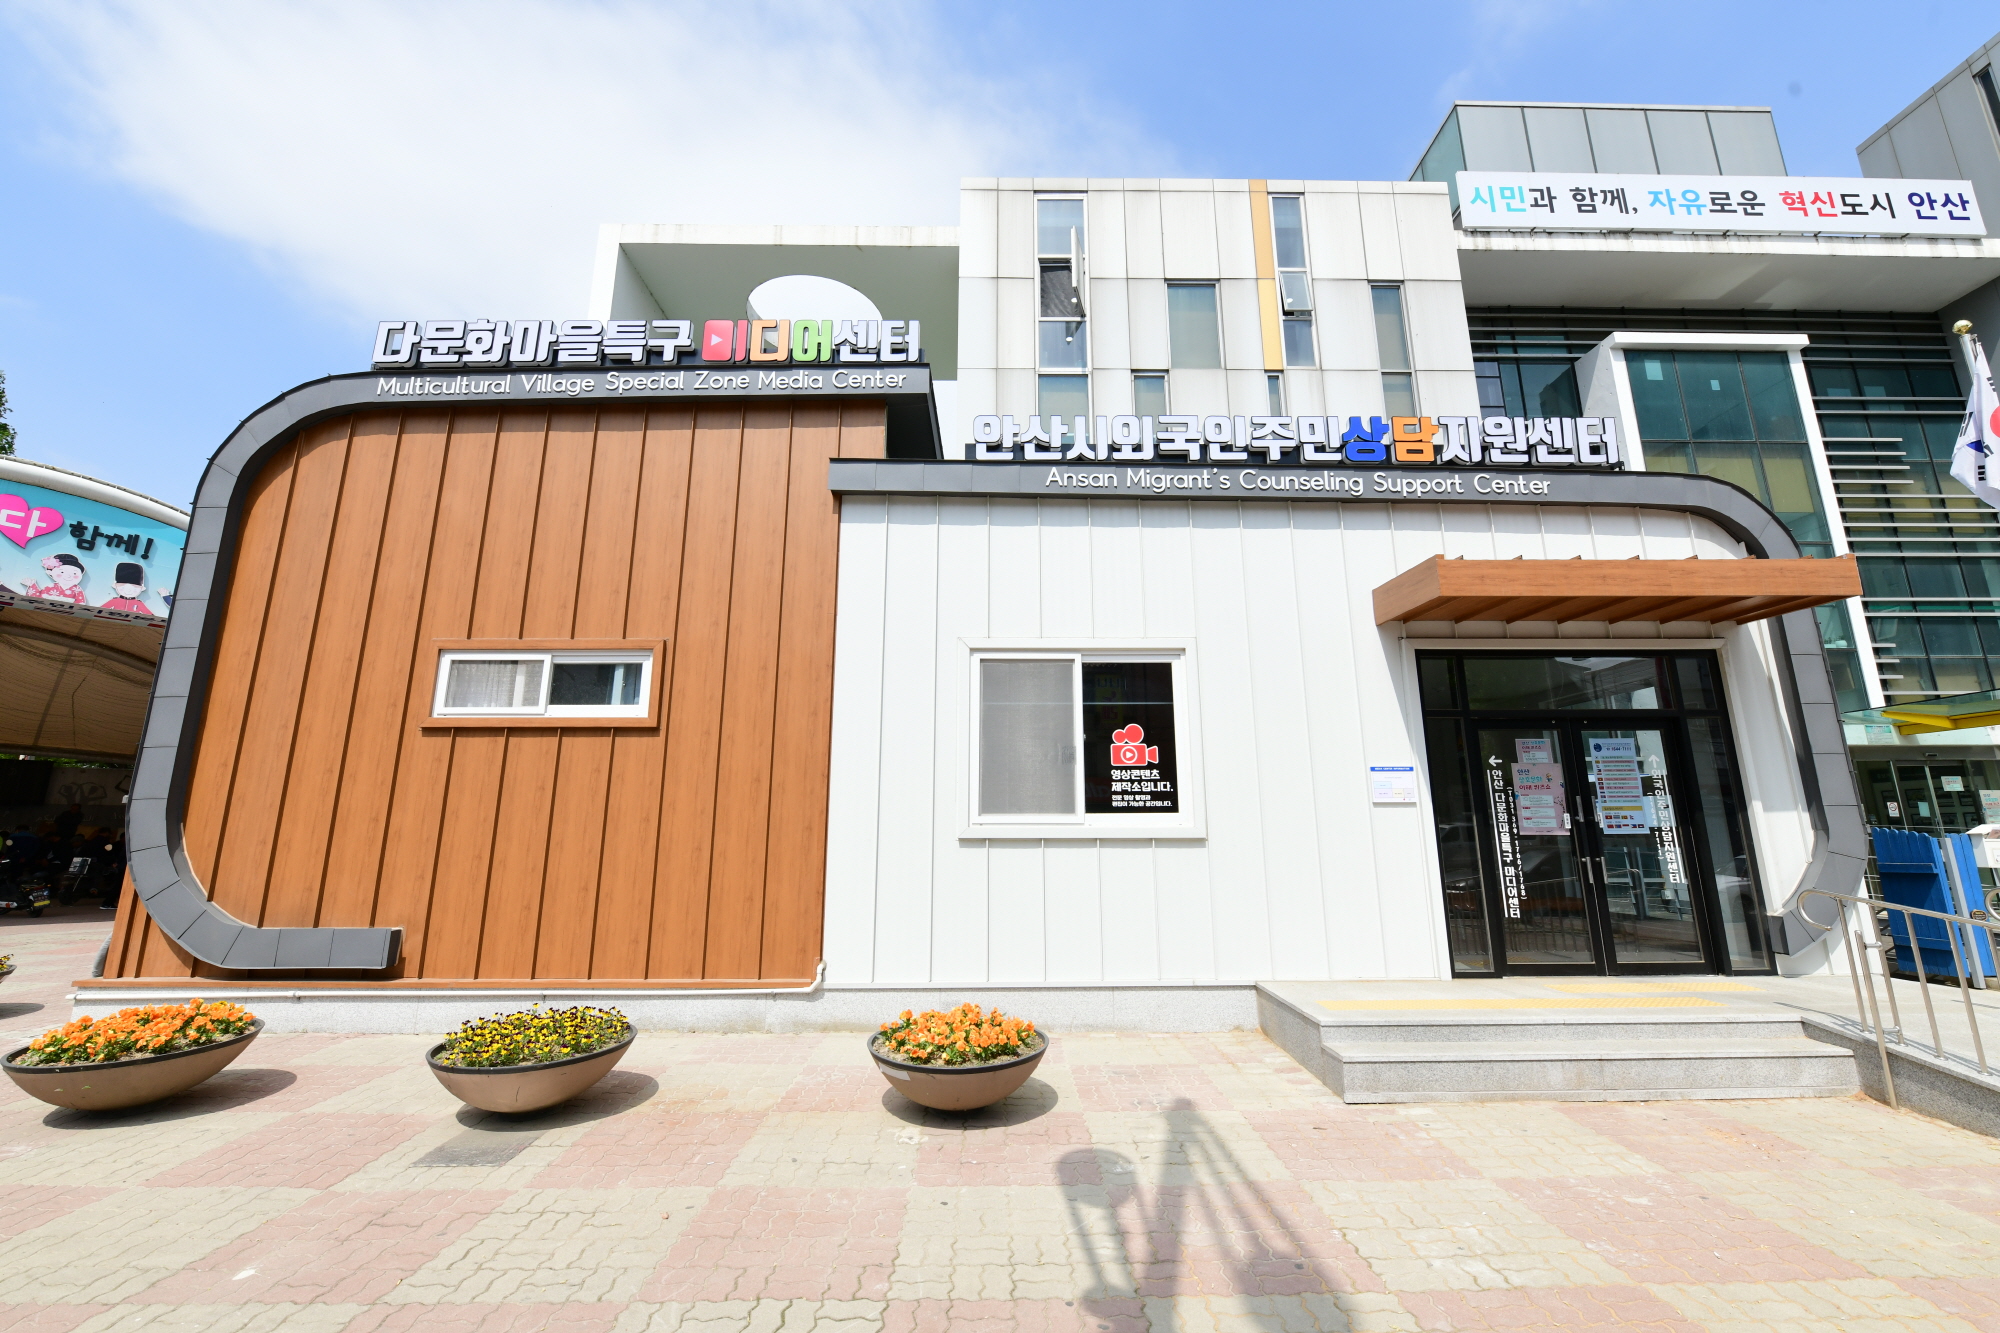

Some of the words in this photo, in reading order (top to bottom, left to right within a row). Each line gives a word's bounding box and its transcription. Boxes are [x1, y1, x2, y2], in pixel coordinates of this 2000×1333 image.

[1470, 185, 1558, 213] 시민과
[1569, 186, 1639, 216] 함께,
[1647, 188, 1766, 217] 자유로운
[1779, 189, 1896, 219] 혁신도시
[1908, 191, 1971, 221] 안산
[372, 319, 692, 366] 다문화마을특구
[702, 319, 921, 363] 미디어센터
[376, 376, 511, 396] Multicultural
[520, 373, 595, 395] Village
[605, 371, 684, 393] Special
[693, 370, 751, 389] Zone
[757, 370, 823, 389] Media
[832, 370, 907, 389] Center
[973, 414, 1620, 464] 안산시외국인주민상담지원센터
[1045, 466, 1118, 489] Ansan
[1126, 466, 1231, 495] Migrant's
[1239, 469, 1364, 496] Counseling
[1372, 471, 1466, 496] Support
[1474, 471, 1551, 496] Center
[69, 521, 154, 559] 함께!
[1111, 769, 1160, 780] 영상콘텐츠
[1111, 781, 1173, 791] 제작소입니다.
[1492, 769, 1504, 790] 안산
[1517, 768, 1530, 776] 안산
[1495, 793, 1514, 863] 다문화마을특구
[1651, 768, 1681, 884] 외국인주민상담지원센터
[1504, 866, 1521, 919] 미디어센터
